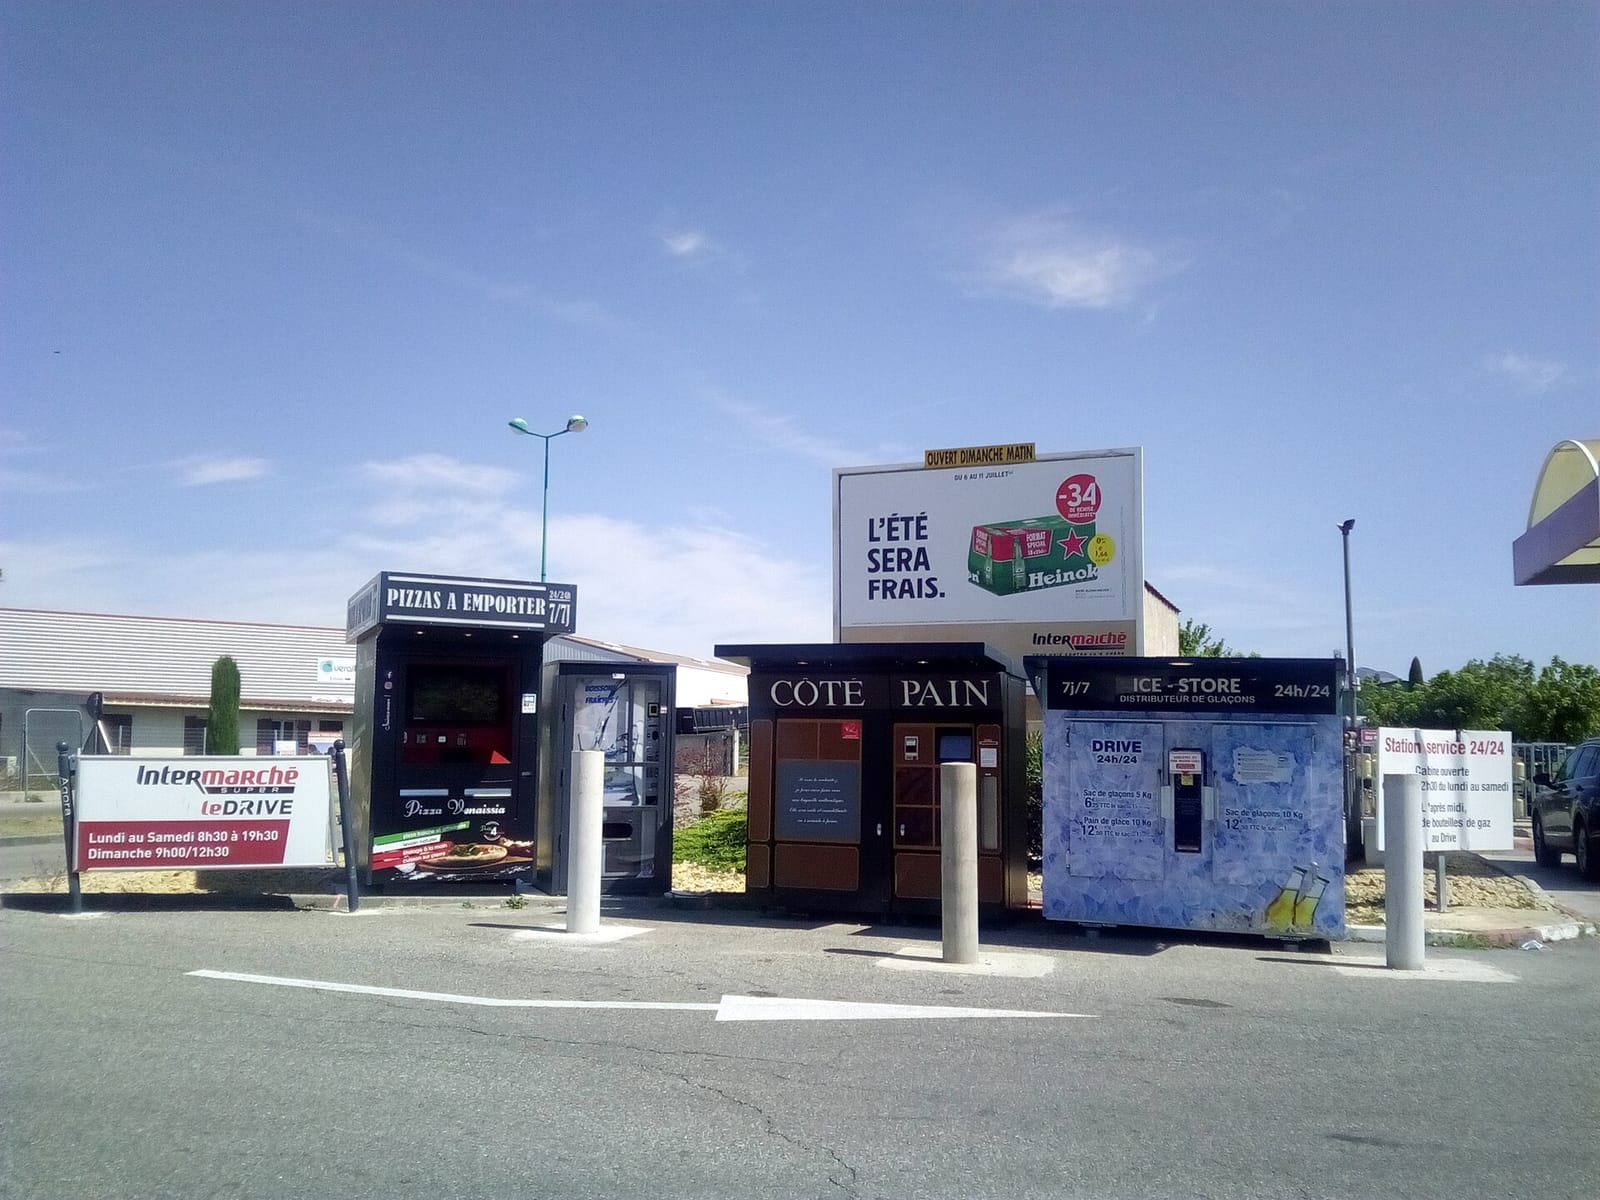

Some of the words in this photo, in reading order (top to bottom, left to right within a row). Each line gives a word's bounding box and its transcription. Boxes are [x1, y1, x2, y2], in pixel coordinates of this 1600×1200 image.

[927, 451, 957, 466] OUVERT
[960, 448, 1003, 463] DIMANCHE
[1006, 445, 1033, 460] MATIN
[868, 512, 928, 542] L'ÉTÉ
[867, 547, 930, 573] SERA
[868, 576, 945, 601] FRAIS.
[387, 588, 441, 609] PIZZAS
[446, 592, 457, 610] A
[463, 593, 546, 615] EMPORTER
[770, 677, 866, 706] CÔTÉ
[901, 679, 990, 706] PAIN
[1062, 682, 1090, 695] 7j/7
[1133, 678, 1161, 692] ICE
[1178, 678, 1241, 693] STORE
[1275, 685, 1330, 698] 24h/24
[1119, 695, 1190, 703] DISTRIBUTEUR
[1192, 695, 1205, 703] DE
[1207, 695, 1256, 705] GLAÇONS
[1092, 740, 1142, 753] DRIVE
[1385, 737, 1421, 754] Station
[1426, 740, 1466, 755] service
[1470, 741, 1504, 755] 24/24
[1097, 755, 1138, 764] 24h/24
[1083, 789, 1096, 797] Sac
[1097, 789, 1106, 797] de
[1107, 790, 1135, 798] glaçons
[1448, 782, 1468, 792] lundi
[1471, 783, 1479, 791] au
[1481, 782, 1509, 792] samedi
[404, 800, 442, 817] Pizza
[1225, 808, 1239, 816] Sac
[1241, 809, 1250, 817] de
[1251, 809, 1280, 818] glaçons
[1293, 811, 1303, 820] Kg
[1100, 817, 1109, 825] de
[1111, 818, 1130, 826] glace
[1132, 818, 1140, 826] 10
[1142, 819, 1152, 828] Kg
[1466, 818, 1476, 828] de
[1477, 819, 1492, 829] gaz
[88, 832, 125, 844] Lundi
[128, 834, 145, 843] au
[147, 830, 194, 843] Samedi
[198, 830, 228, 842] 8h30
[230, 830, 239, 842] à
[242, 830, 279, 841] 19h30
[1440, 832, 1456, 843] Drive
[88, 847, 152, 859] Dimanche
[155, 846, 229, 859] 9h00/12h30
